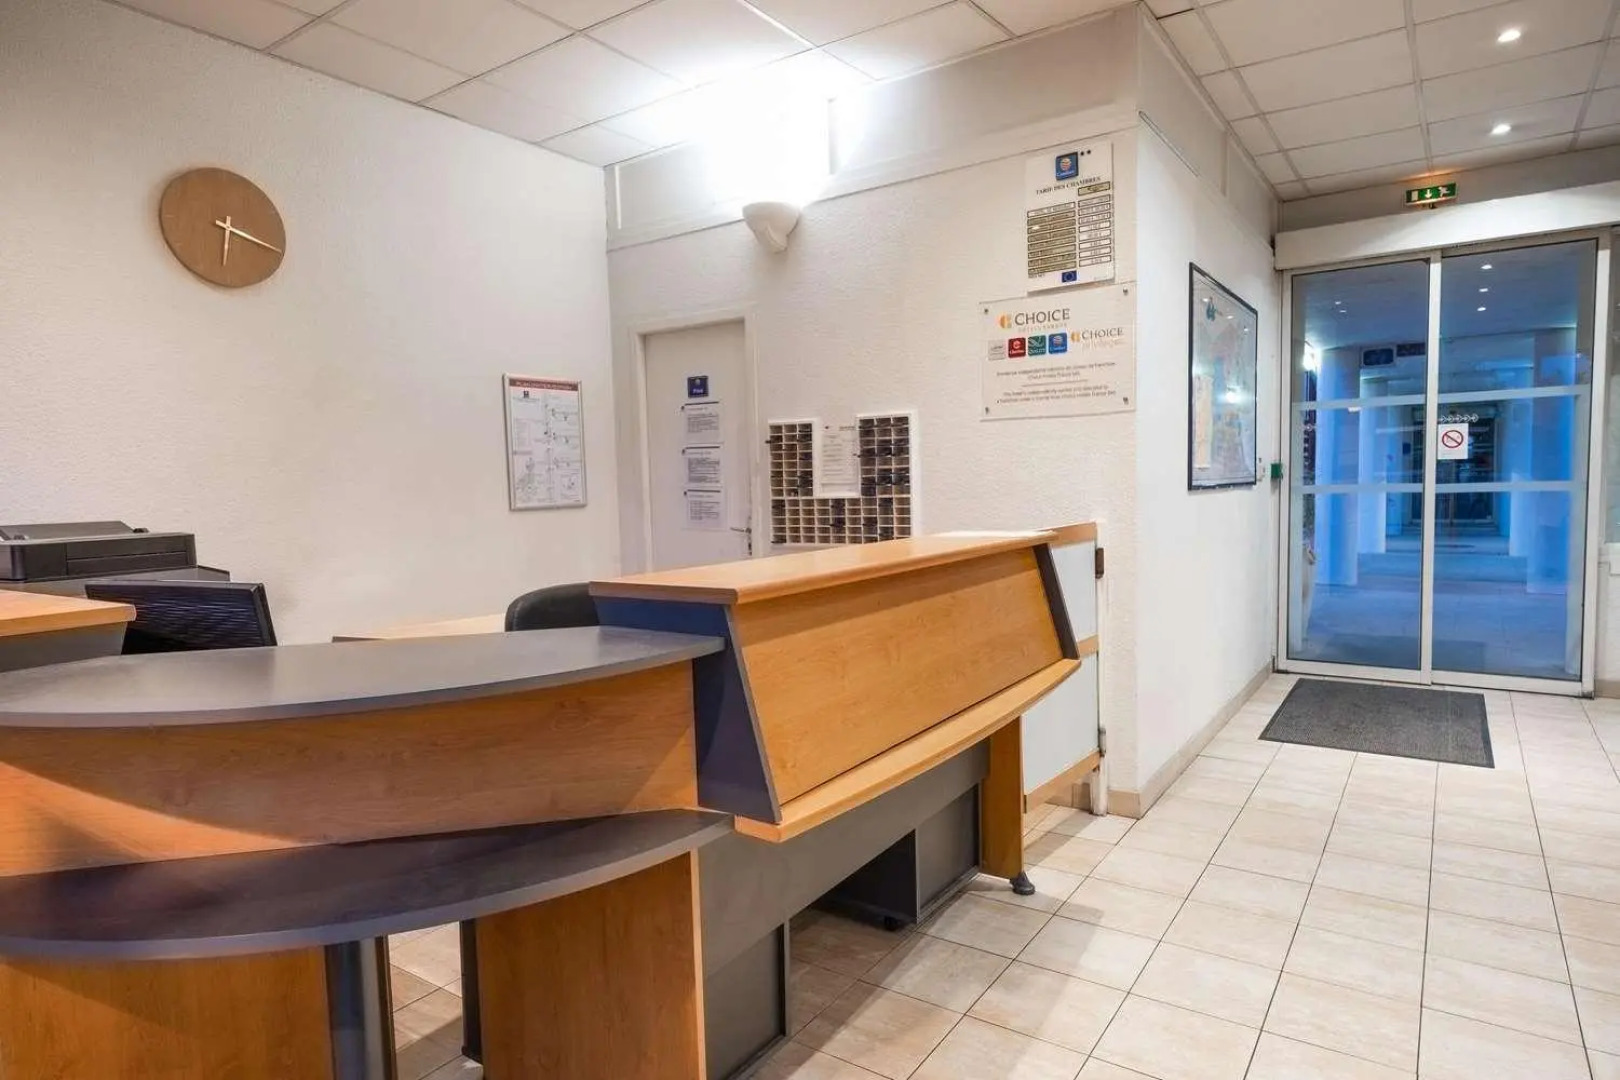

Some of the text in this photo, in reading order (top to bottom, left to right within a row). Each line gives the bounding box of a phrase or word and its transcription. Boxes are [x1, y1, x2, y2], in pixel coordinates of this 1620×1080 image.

[1066, 176, 1101, 188] CHAMBRES
[1014, 308, 1071, 325] CHOICE
[1081, 327, 1124, 341] CHOICE
